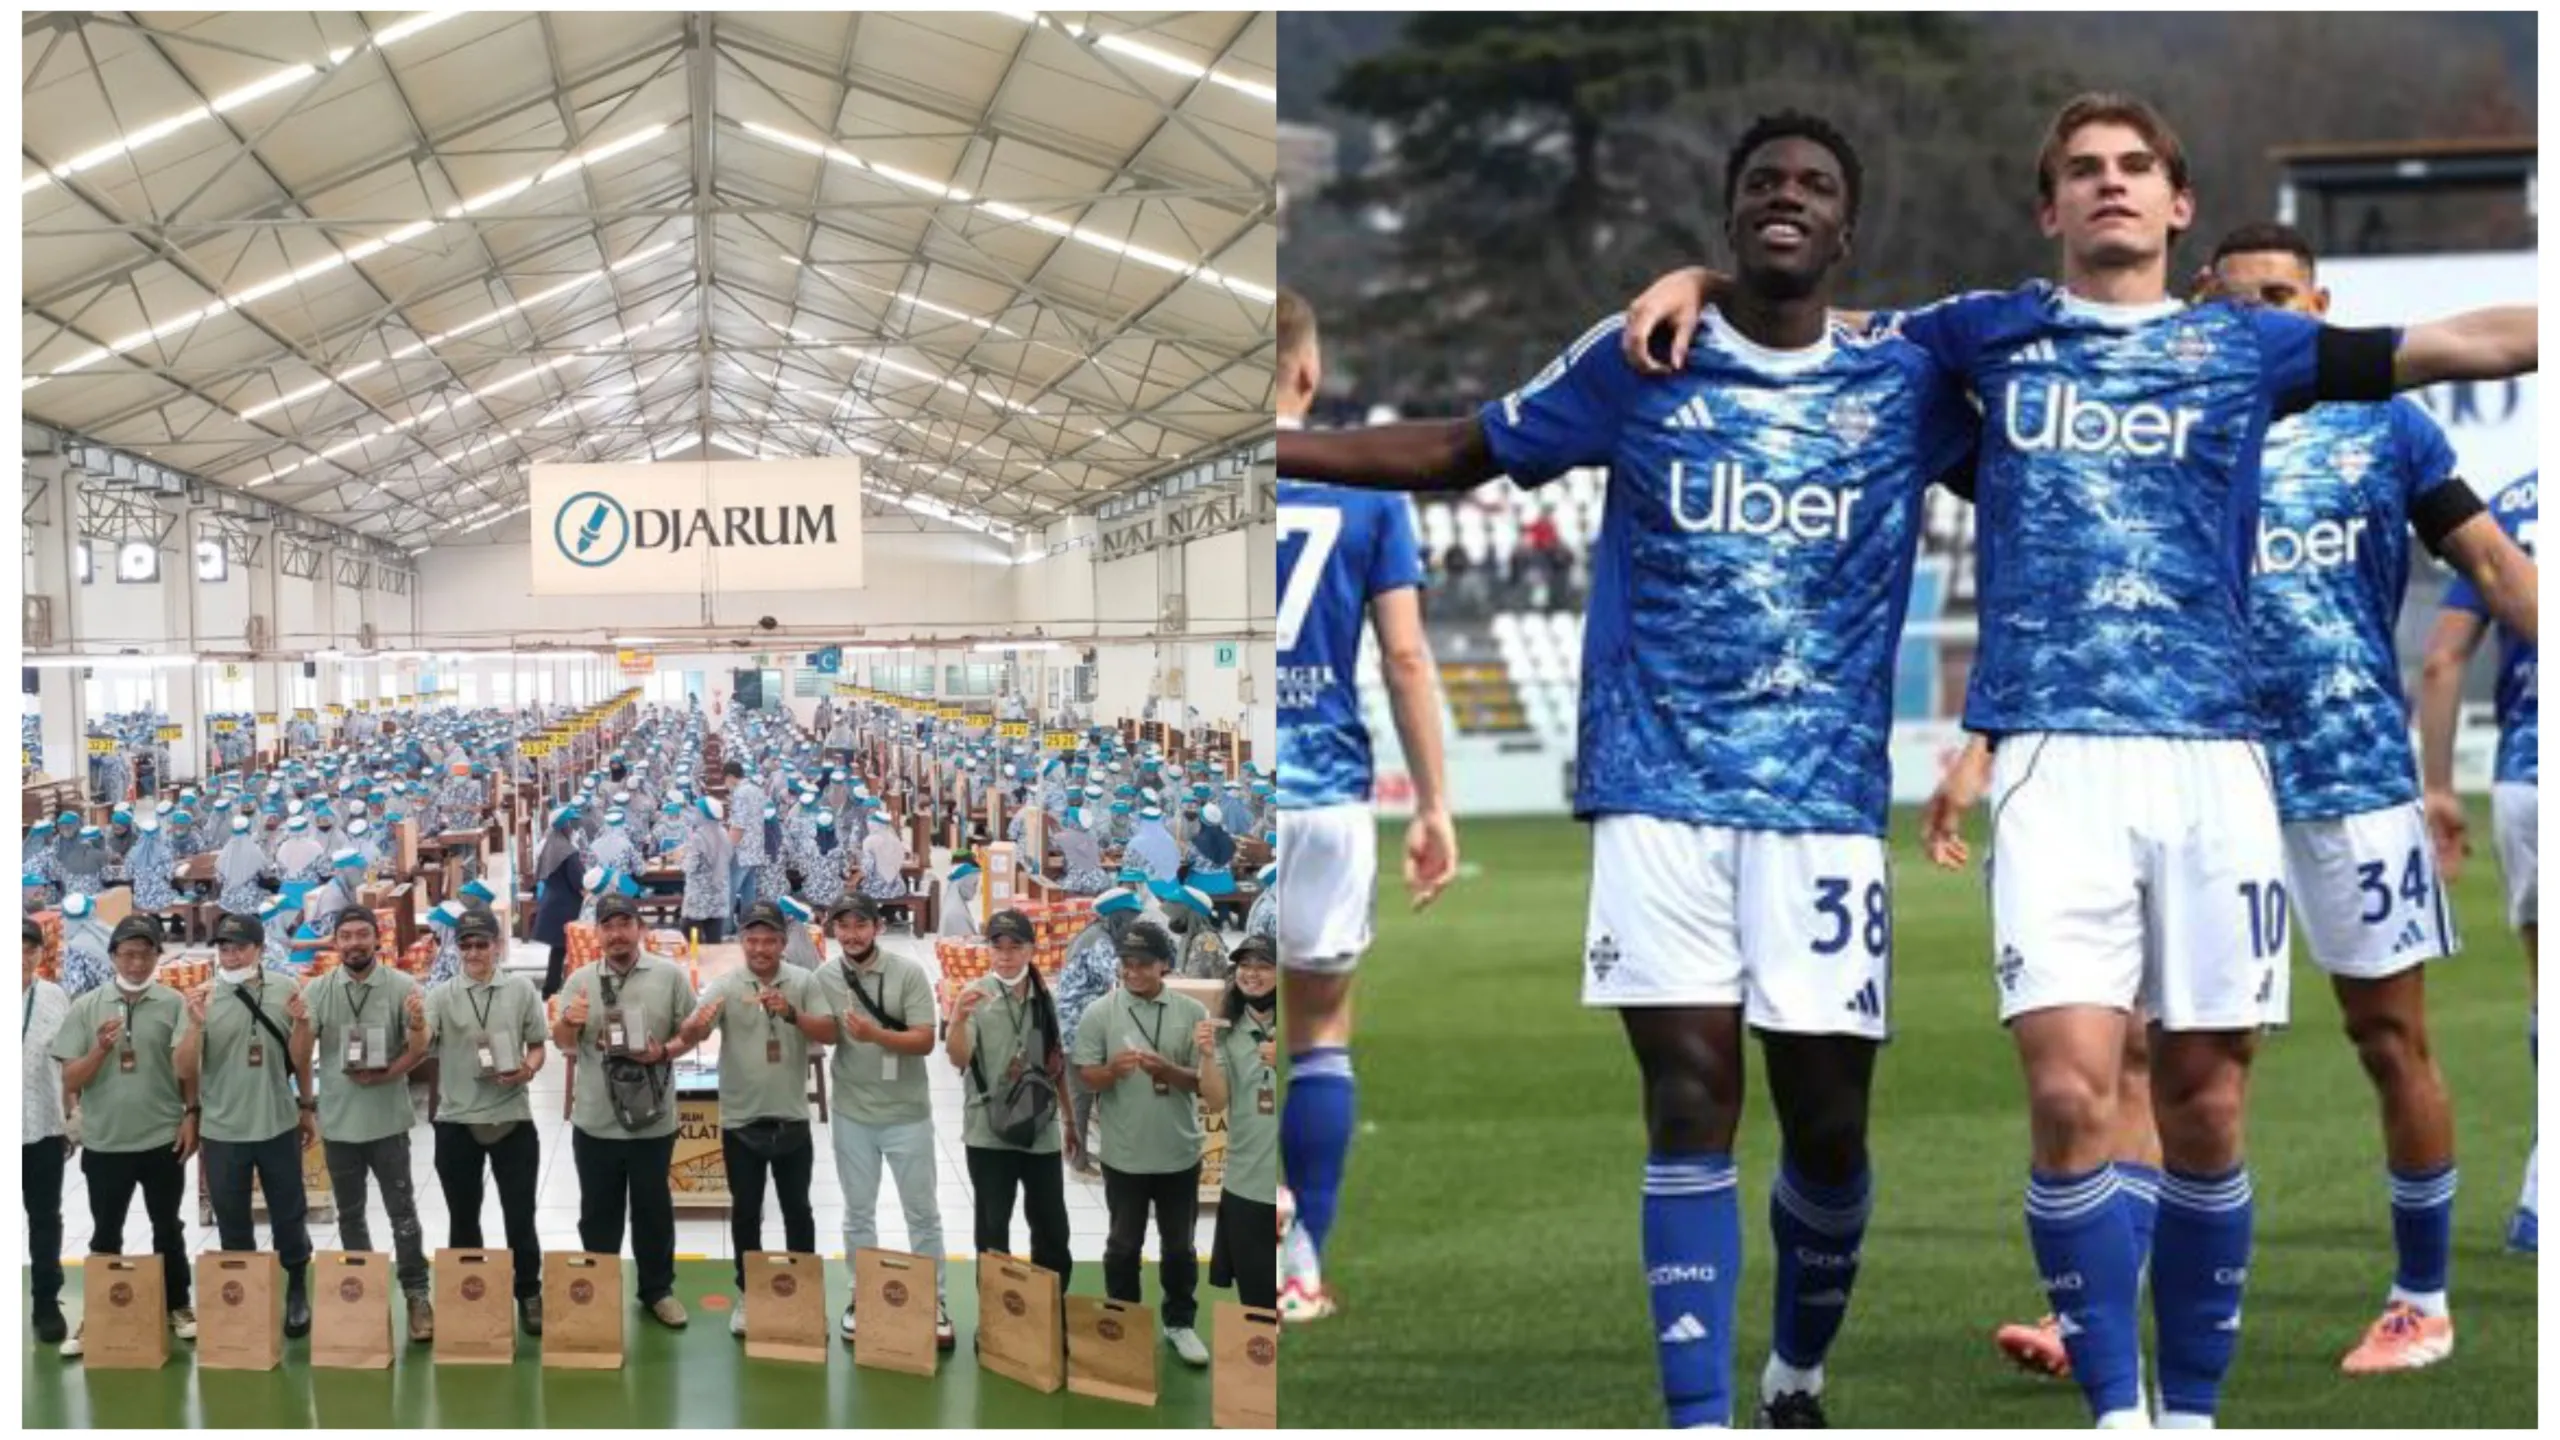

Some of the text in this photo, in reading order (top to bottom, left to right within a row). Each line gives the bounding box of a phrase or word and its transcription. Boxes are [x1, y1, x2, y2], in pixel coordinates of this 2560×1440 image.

[2005, 380, 2204, 459] Uber
[633, 504, 838, 553] DJARUM
[1670, 460, 1865, 542] Uber
[2251, 516, 2368, 576] ber
[821, 652, 835, 670] C
[1219, 647, 1233, 663] D
[1810, 876, 1886, 958] 38
[2238, 878, 2286, 958] 10
[2357, 846, 2428, 925] 34
